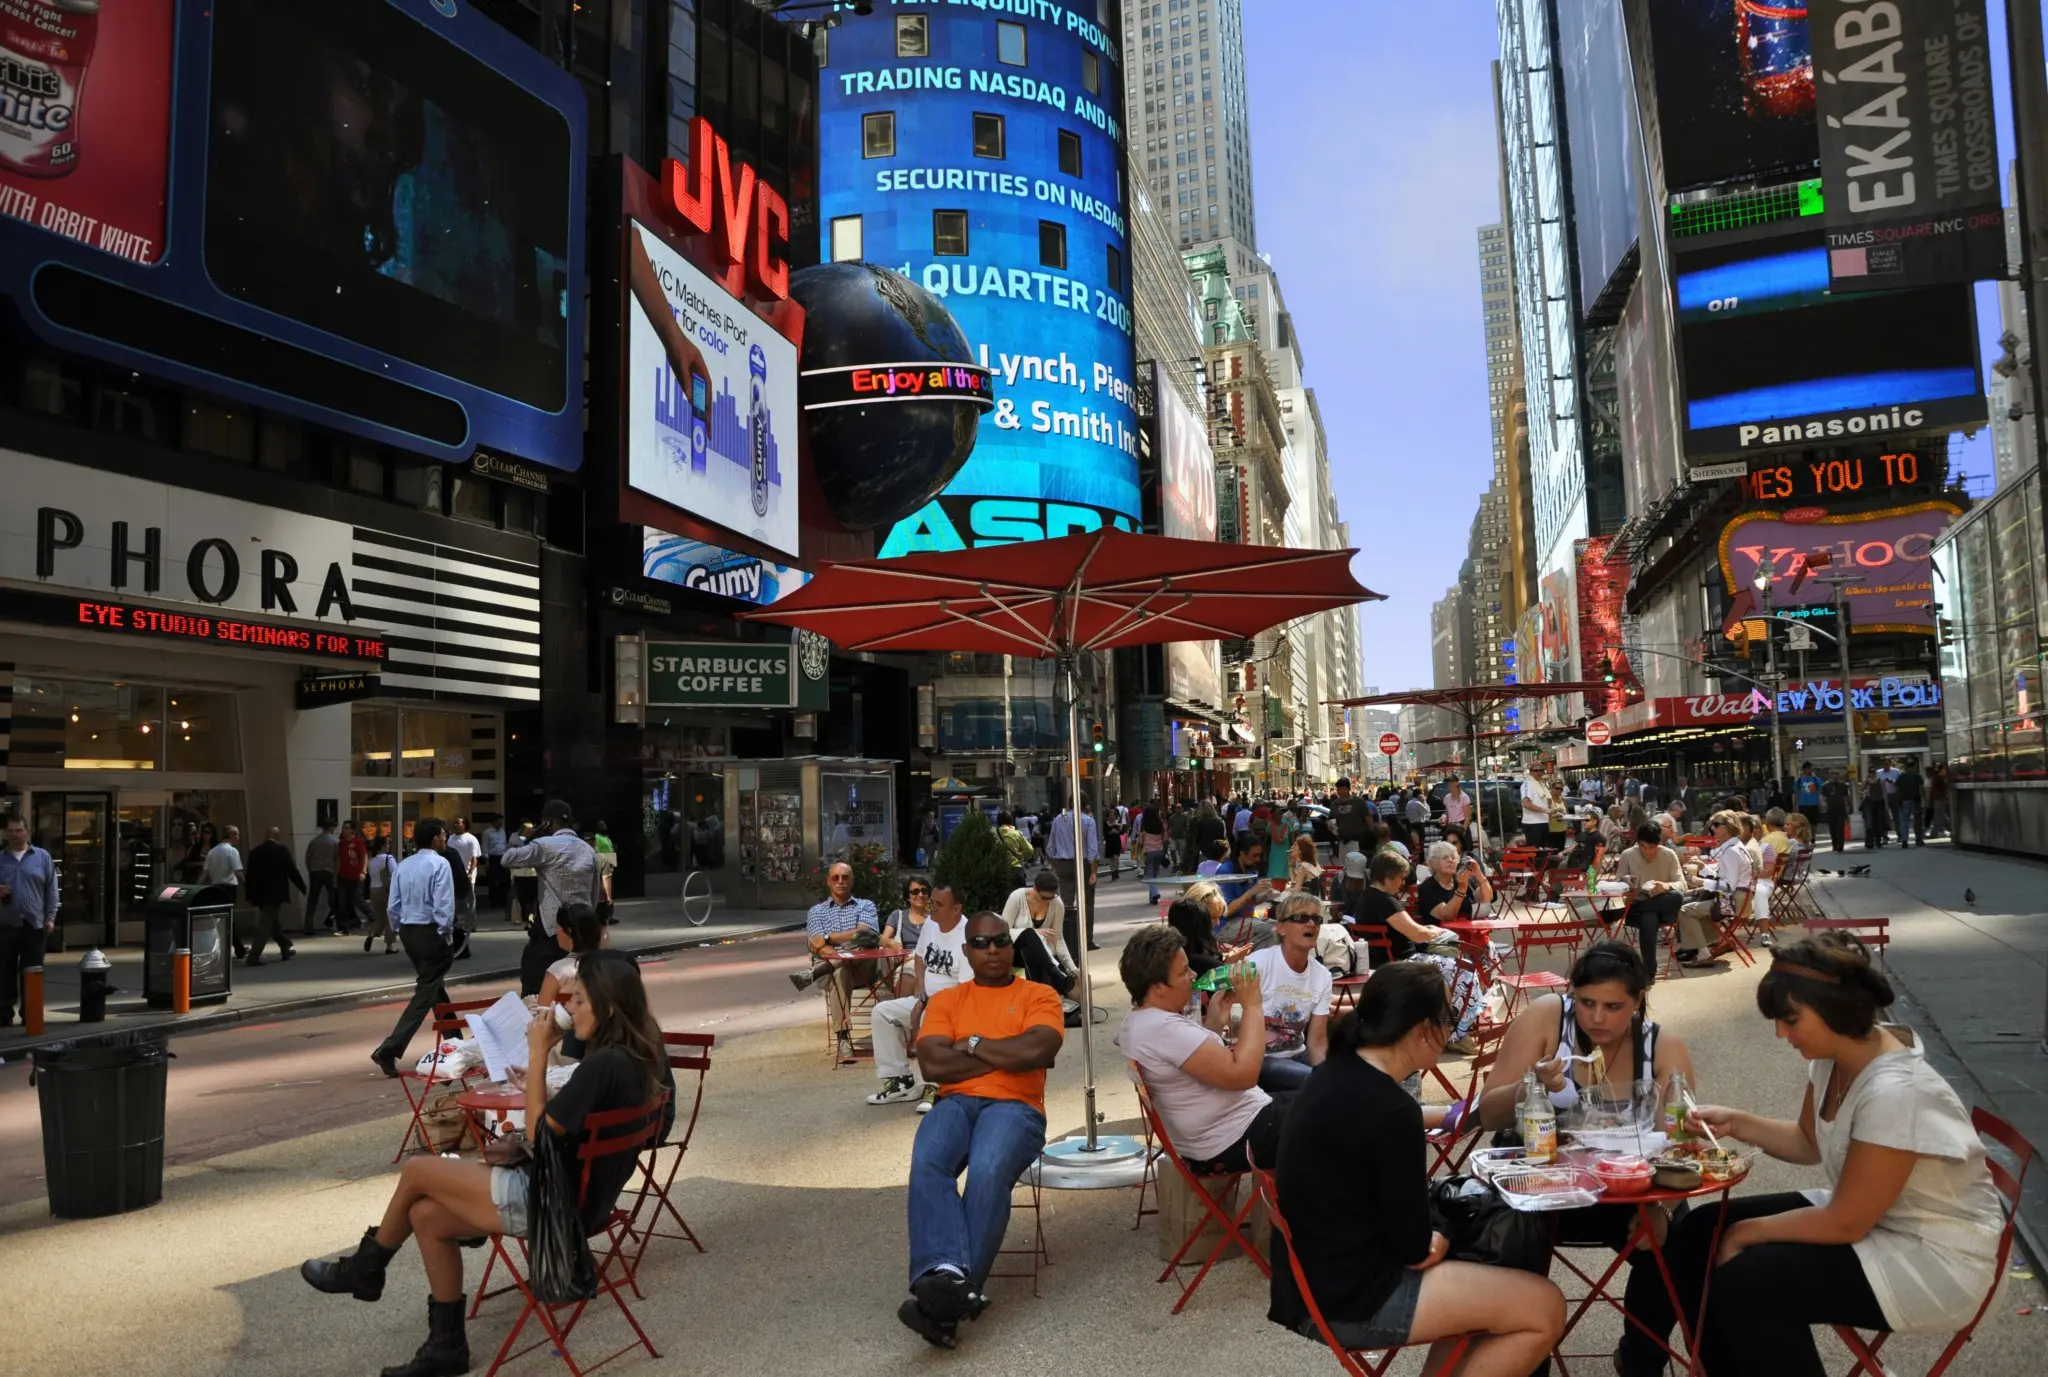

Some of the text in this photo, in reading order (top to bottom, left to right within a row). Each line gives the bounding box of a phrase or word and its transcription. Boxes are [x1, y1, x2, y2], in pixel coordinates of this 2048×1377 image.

[33, 2, 62, 22] Fight
[34, 17, 76, 38] Cancer!
[952, 0, 1061, 25] IDITY
[841, 67, 961, 95] TRADING
[970, 70, 1066, 112] NASDAQ
[1074, 96, 1106, 131] AND
[1822, 0, 1916, 213] EKÁÁB
[1924, 34, 1960, 199] TIMES SQUARE
[1954, 12, 1993, 191] CROSSROADS OF
[52, 142, 71, 157] 60
[661, 115, 788, 301] JVC
[877, 168, 1125, 240] SECURITIES ON NASDAQ
[40, 202, 97, 244] ORBIT
[100, 223, 152, 265] WHITE.
[675, 278, 721, 328] Matches
[923, 264, 1090, 314] QUARTER
[1096, 289, 1132, 338] 2009
[1707, 295, 1738, 313] on
[682, 309, 697, 335] for
[700, 326, 729, 356] color
[852, 368, 925, 395] Enjoy
[928, 366, 952, 389] all
[955, 368, 980, 389] the
[980, 343, 1086, 394] Lynch,
[994, 398, 1020, 430] &
[1031, 400, 1114, 446] Smith
[1740, 407, 1924, 447] Panasonic
[1692, 465, 1746, 479] SHERWOOD
[1810, 458, 1863, 495] YOU
[1880, 453, 1918, 486] TO
[1783, 509, 1824, 521] VACANCY
[36, 507, 356, 622] PHORA
[686, 564, 763, 599] Gumy
[79, 603, 385, 659] EYE STUDIO SEMINARS FOR THE
[302, 678, 365, 694] SEPHORA
[652, 656, 787, 675] STARBUCKS
[677, 676, 763, 693] COFFEE
[803, 658, 824, 677] COFFEE
[1880, 676, 1941, 708] POLI
